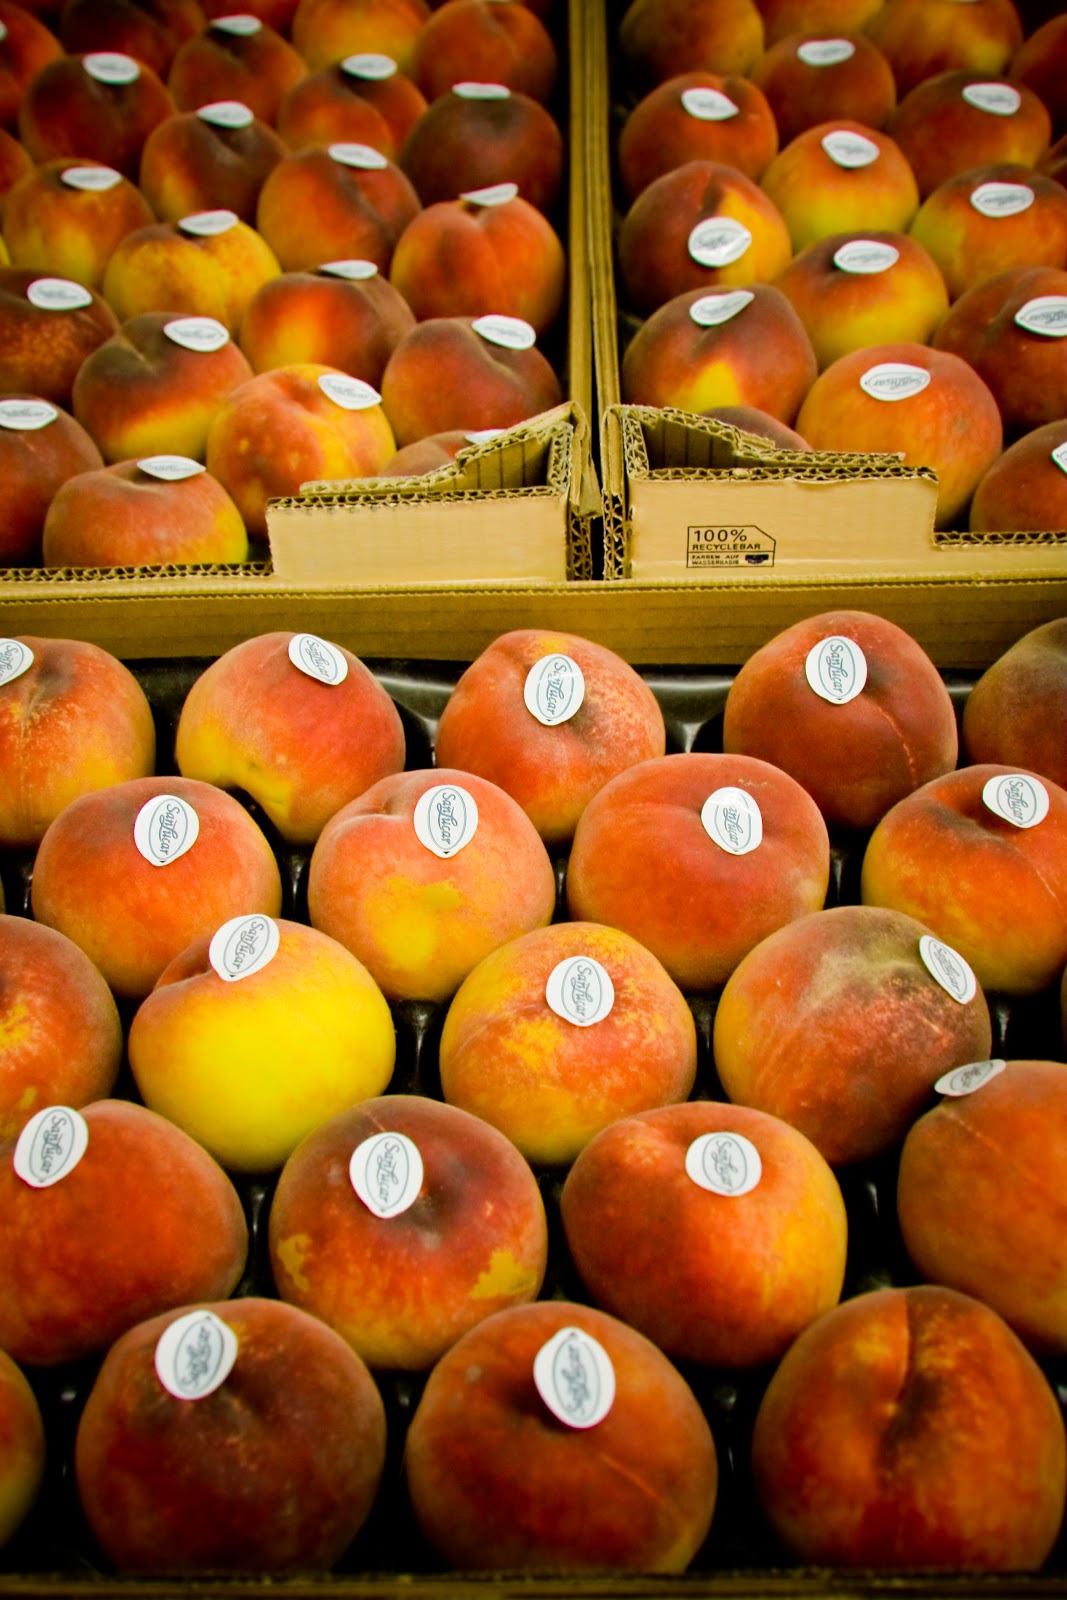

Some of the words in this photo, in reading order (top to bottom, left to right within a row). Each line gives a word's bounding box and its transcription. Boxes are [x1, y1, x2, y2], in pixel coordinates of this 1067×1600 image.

[692, 543, 761, 551] RECYCLEBAR
[694, 529, 747, 542] 100%
[303, 640, 330, 678] SanLucar
[826, 644, 848, 694] SanLucar
[437, 792, 458, 844] SanLucar
[1005, 780, 1028, 821] SanLucar
[158, 804, 181, 856] SanLucar
[232, 921, 264, 970] SanLucar
[571, 965, 593, 1017] SanLucar
[41, 1116, 67, 1173] SanLucar
[711, 1140, 737, 1187] SanLucar
[377, 1142, 400, 1204] SanLucar
